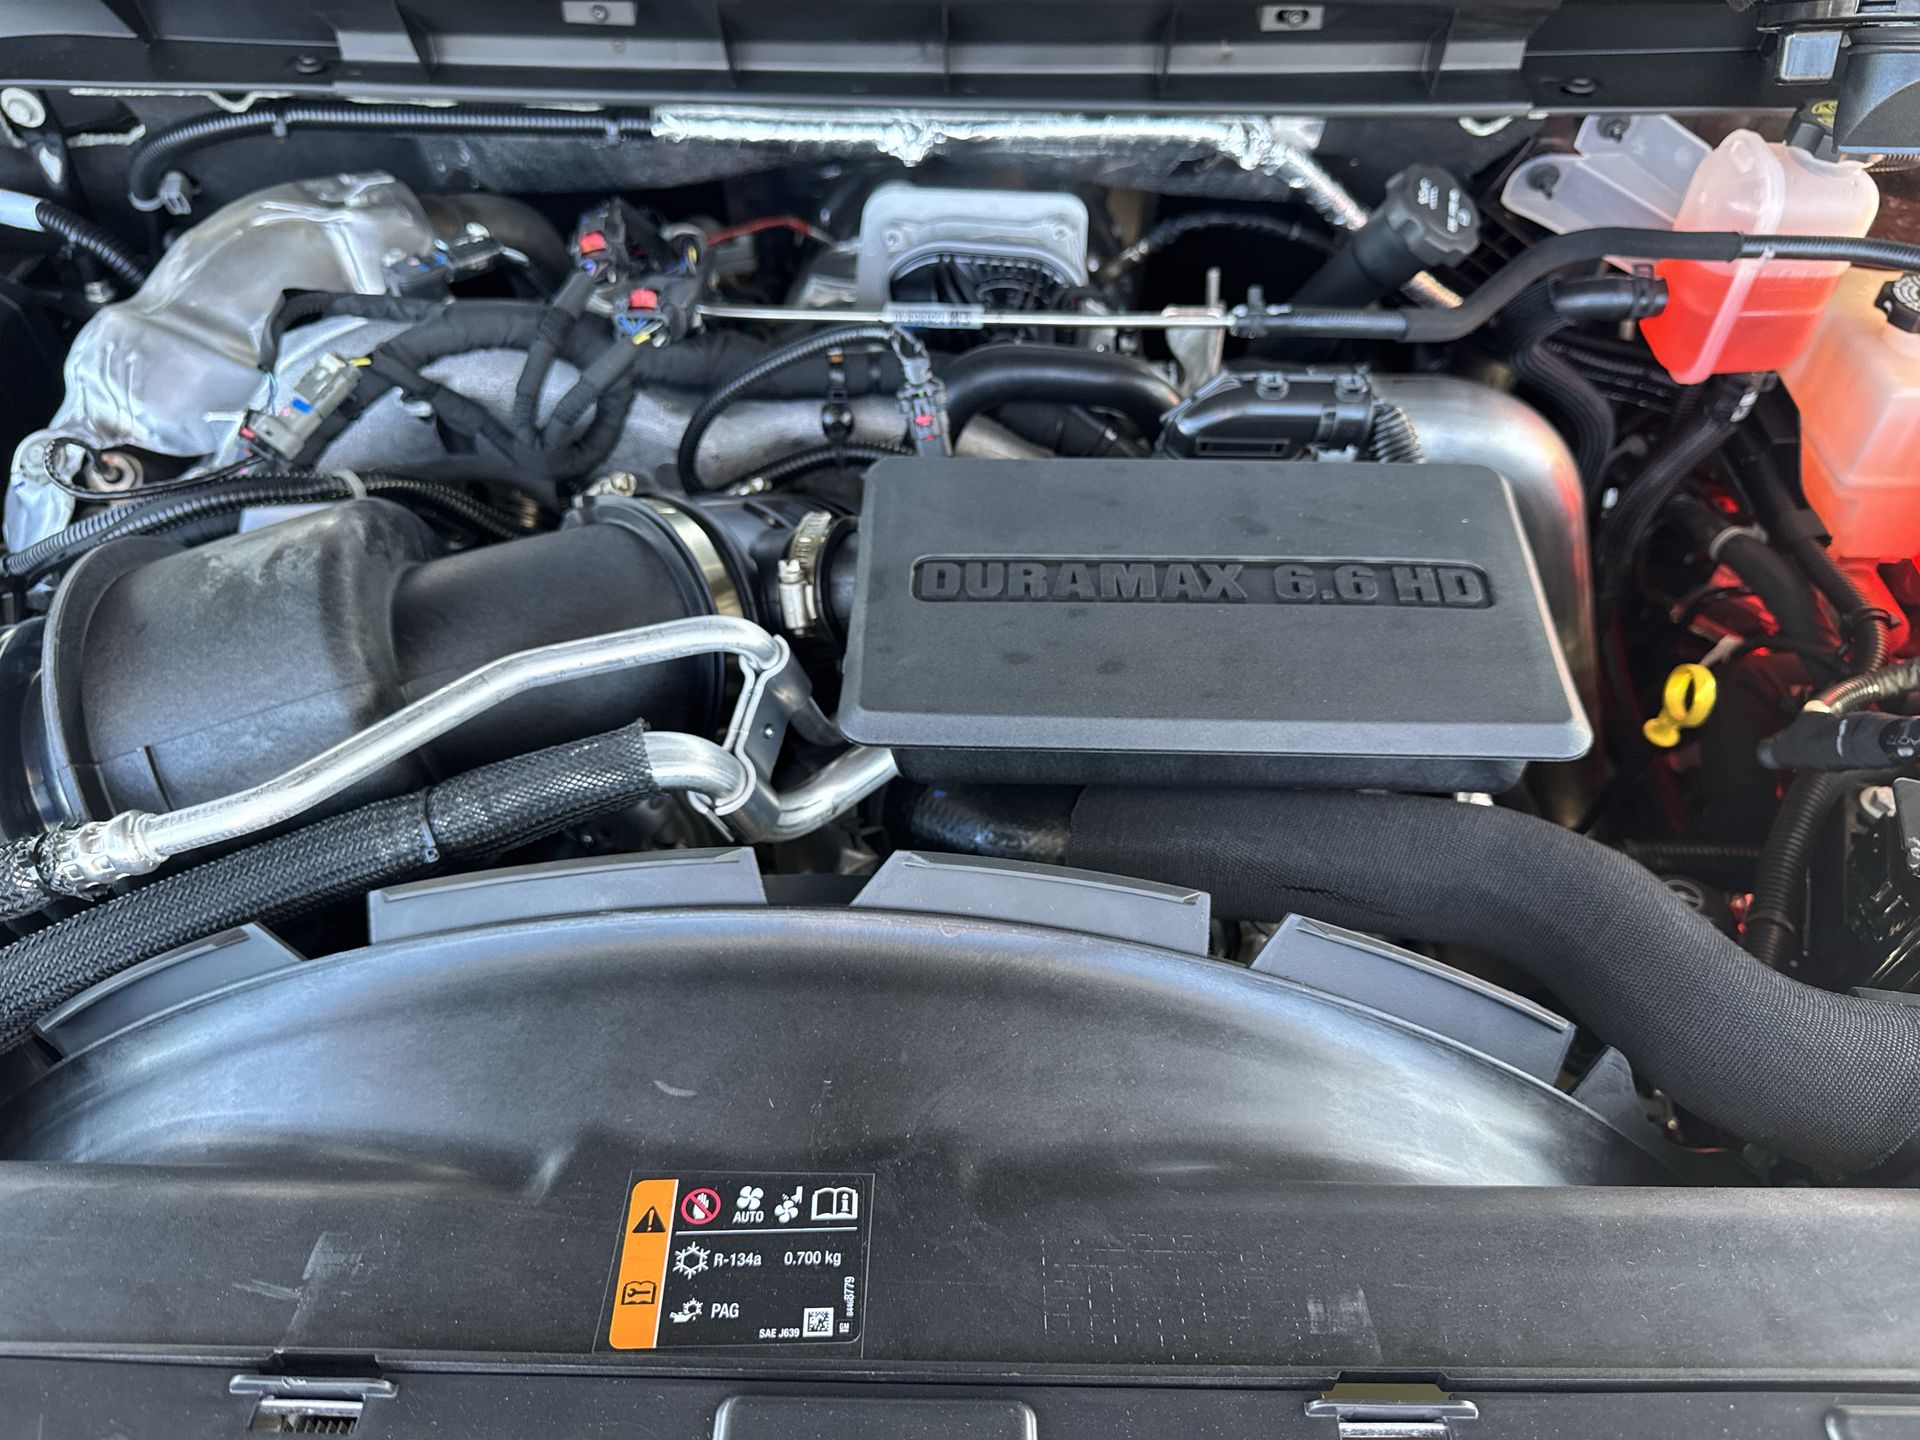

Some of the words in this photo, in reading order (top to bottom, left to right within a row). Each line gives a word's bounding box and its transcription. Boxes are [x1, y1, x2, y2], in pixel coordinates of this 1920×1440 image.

[921, 562, 1248, 600] DURAMAX
[1273, 564, 1378, 600] 6.6
[1392, 566, 1483, 603] HD
[732, 1210, 764, 1224] AUTO
[713, 1252, 762, 1268] R-134a
[784, 1250, 821, 1266] 0.700
[825, 1250, 842, 1267] kg
[710, 1302, 740, 1319] PAG
[759, 1328, 777, 1339] SAE
[778, 1327, 801, 1338] J639
[839, 1322, 850, 1333] GM
